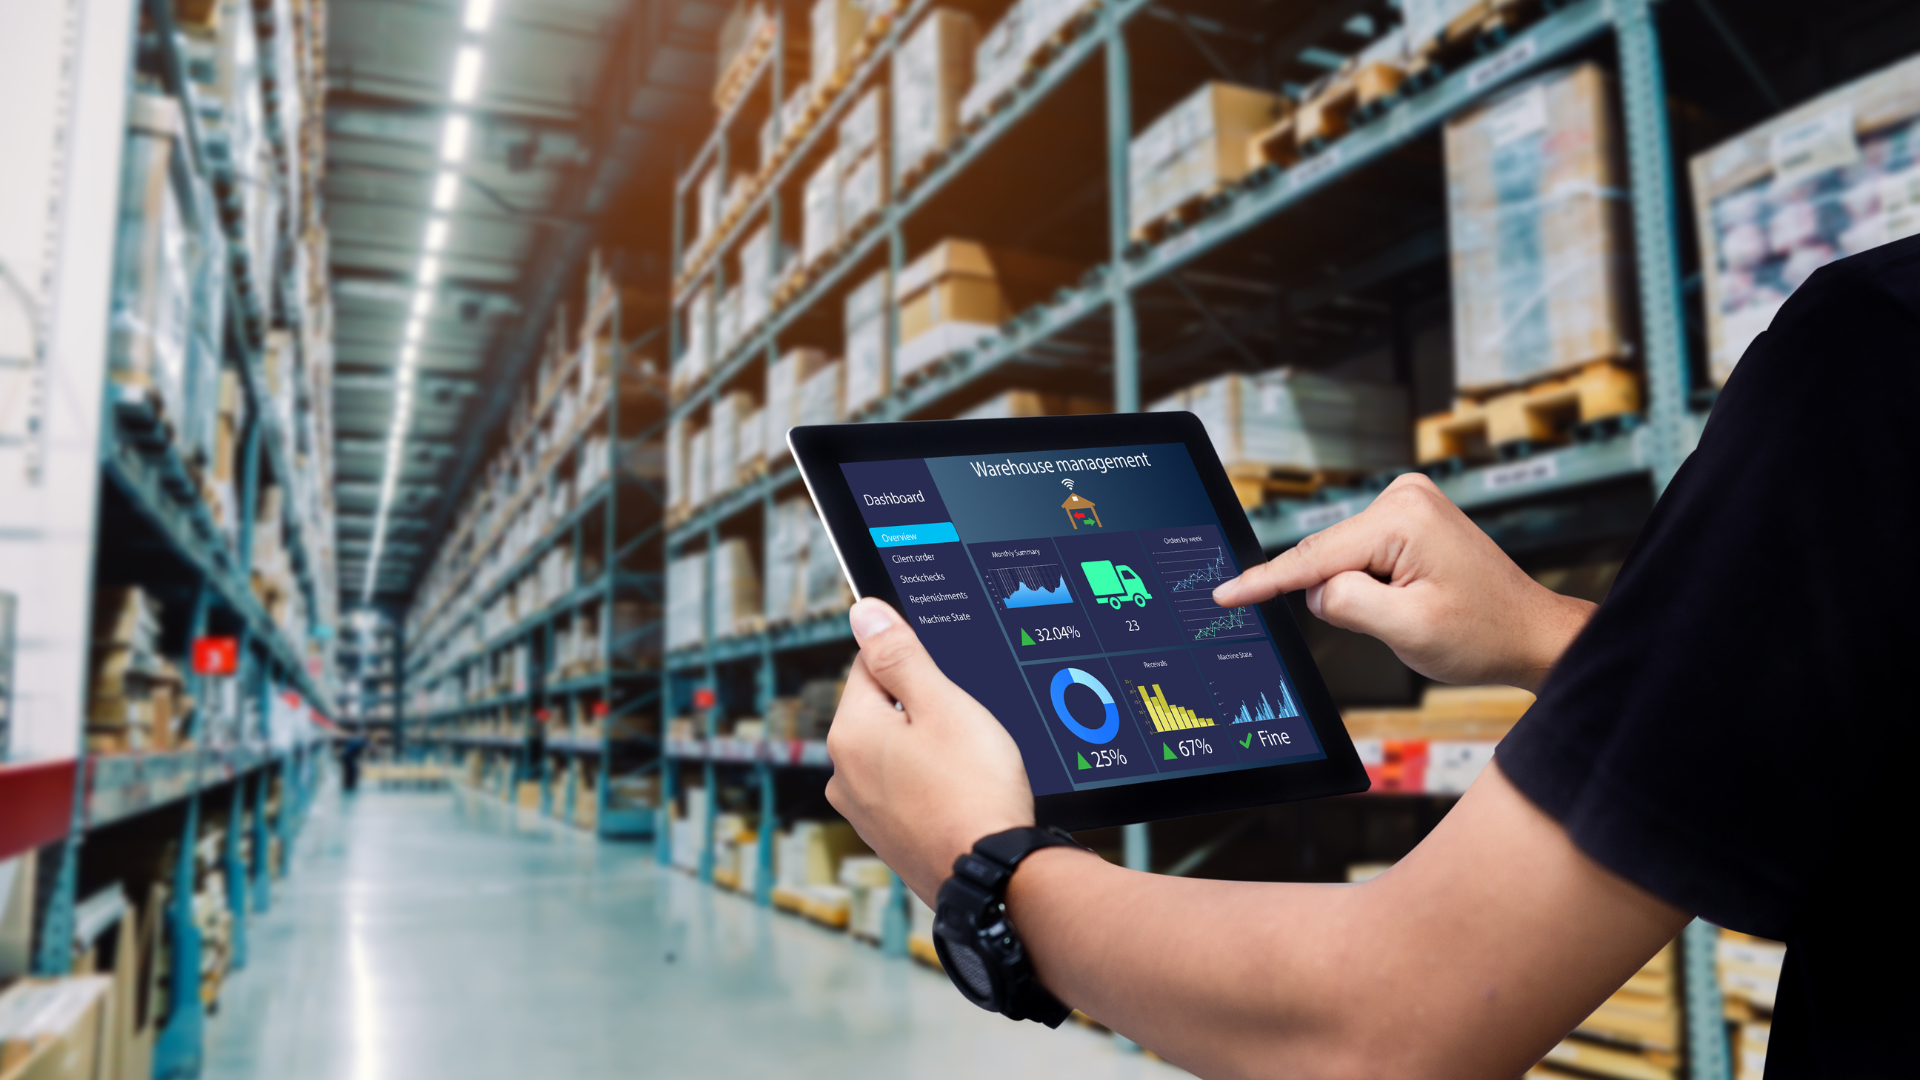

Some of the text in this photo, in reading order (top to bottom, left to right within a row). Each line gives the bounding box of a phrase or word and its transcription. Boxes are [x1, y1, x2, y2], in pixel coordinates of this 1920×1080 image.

[970, 453, 1152, 478] Warehouse management
[863, 490, 926, 507] Dashboard
[881, 532, 917, 543] Overview
[1163, 535, 1203, 546] Orders by week
[915, 553, 935, 562] order
[991, 549, 1040, 559] Monthly Summary
[899, 573, 946, 584] Stockchecks
[908, 592, 969, 605] Replenishments
[918, 613, 971, 625] Machine State
[1126, 620, 1141, 632] 23
[1035, 626, 1080, 642] 32.04%
[1217, 651, 1254, 661] Machine State
[1258, 730, 1291, 747] Fine
[1179, 739, 1213, 757] 67%
[1091, 749, 1128, 768] 25%
